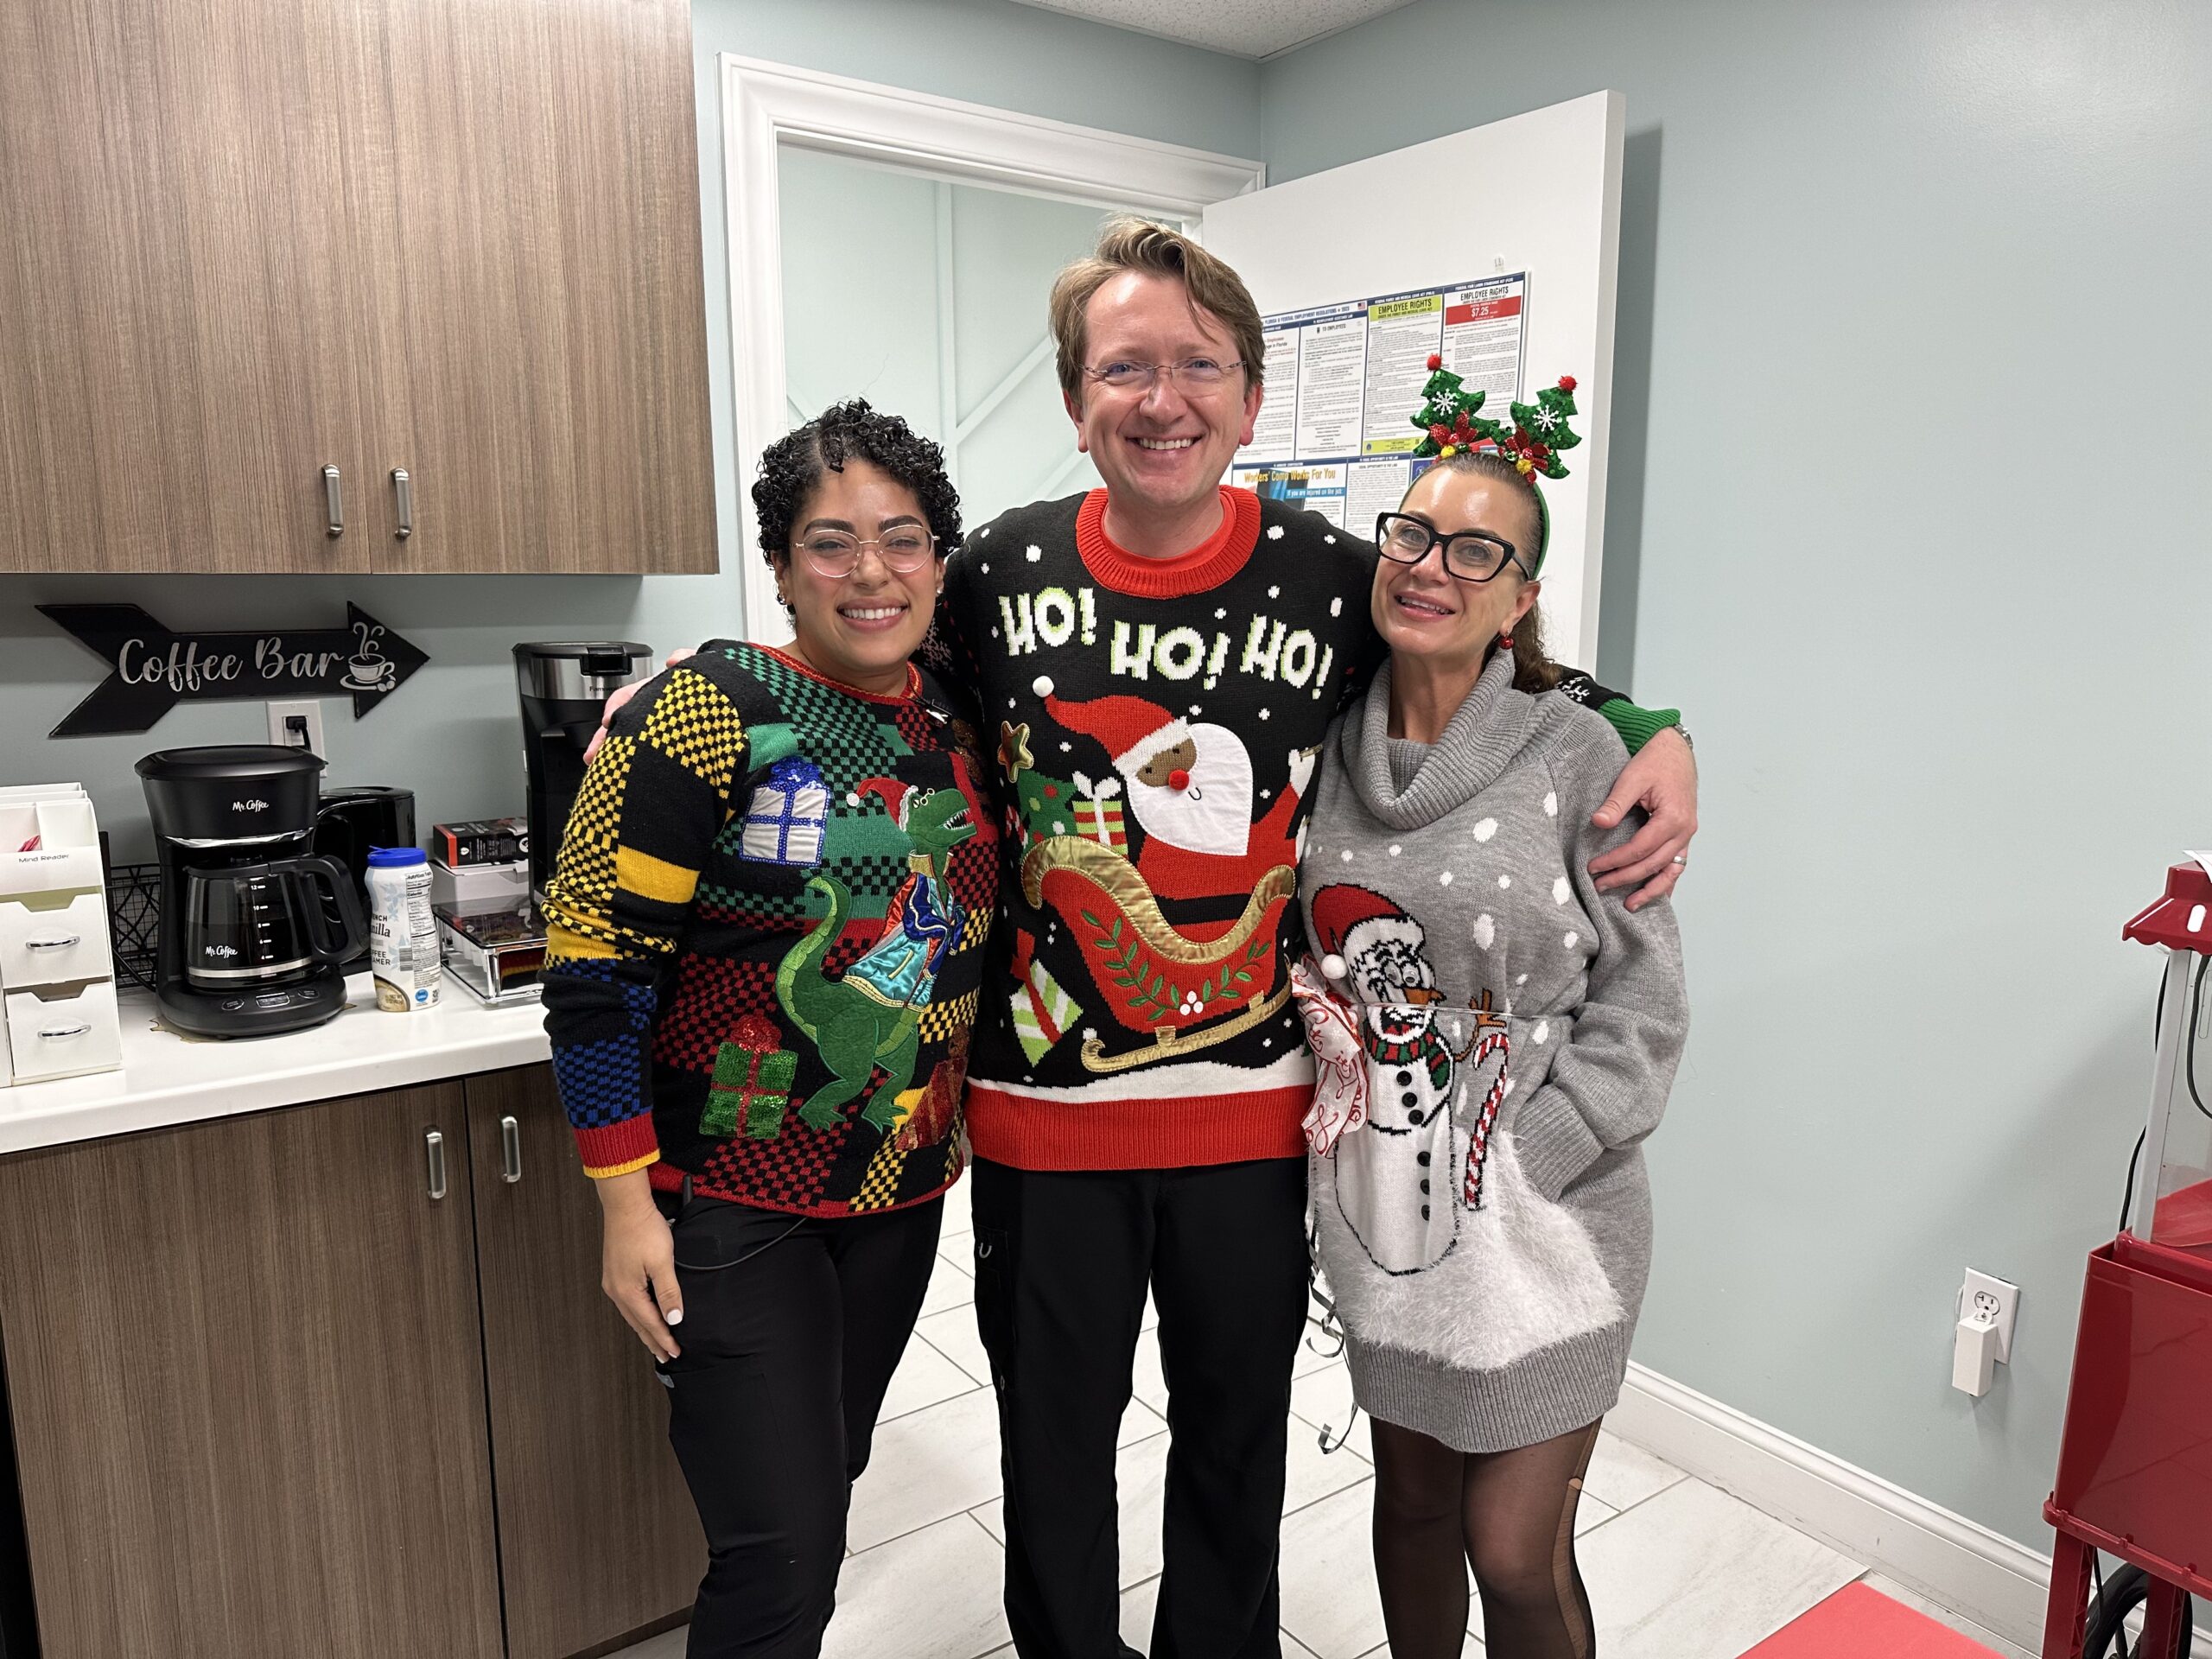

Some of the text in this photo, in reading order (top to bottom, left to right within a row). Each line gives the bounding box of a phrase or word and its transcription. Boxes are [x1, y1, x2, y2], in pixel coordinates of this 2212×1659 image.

[1460, 289, 1488, 302] EMPLOYEE
[1490, 286, 1509, 296] RIGHTS
[1378, 299, 1432, 314] EMPLOYEE RIGHTS
[1471, 306, 1489, 318] $7.25
[1244, 467, 1336, 484] Workers' Comp Works For You
[998, 587, 1333, 700] HO! HO! HO!
[118, 637, 345, 692] Coffee Bar
[246, 799, 269, 812] Coffee
[216, 945, 238, 958] Coffee
